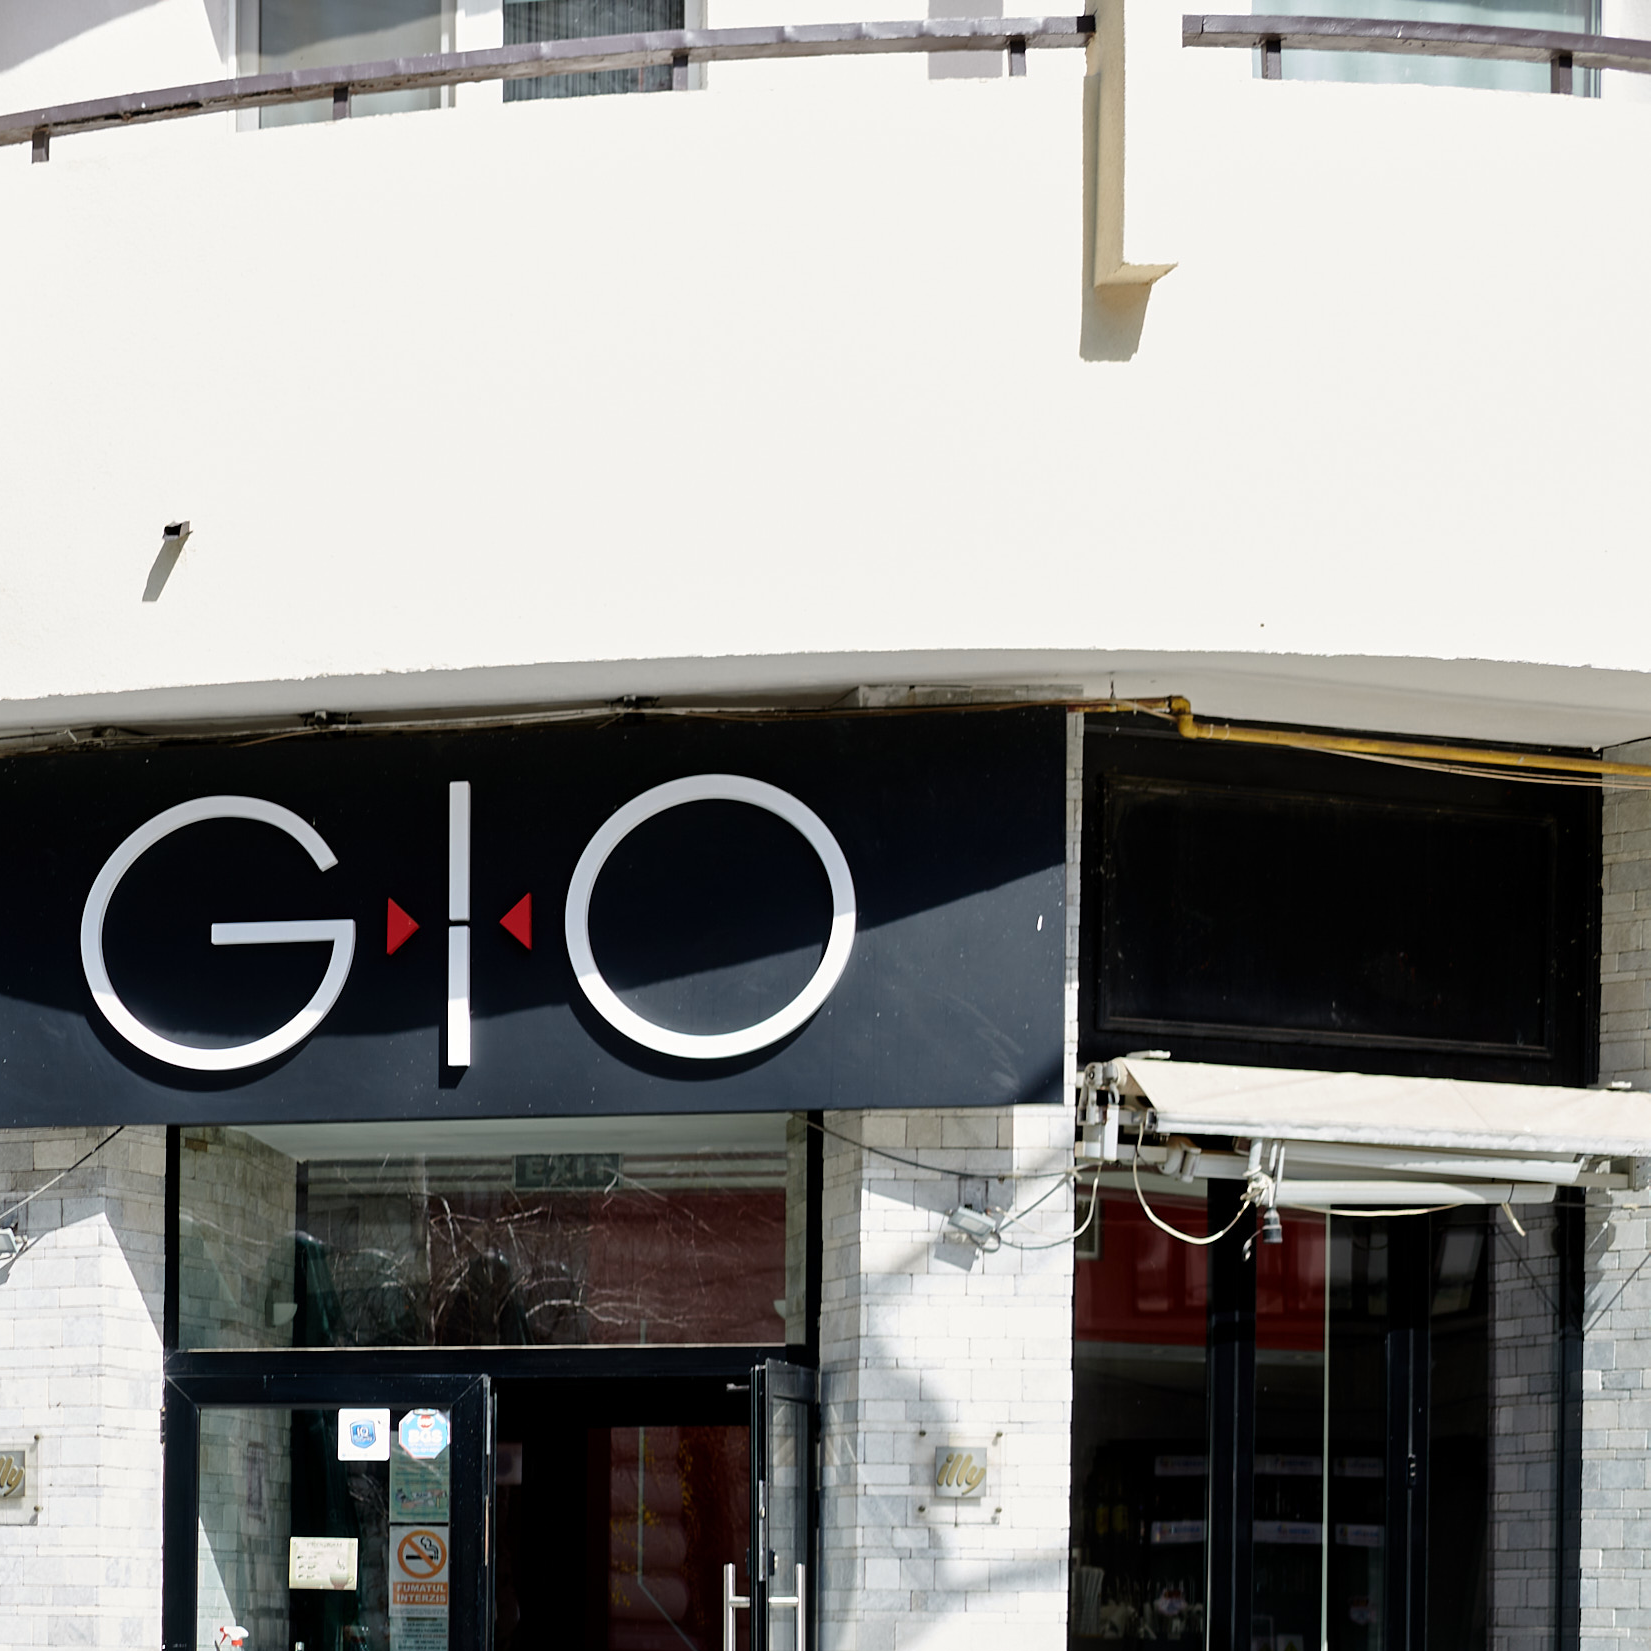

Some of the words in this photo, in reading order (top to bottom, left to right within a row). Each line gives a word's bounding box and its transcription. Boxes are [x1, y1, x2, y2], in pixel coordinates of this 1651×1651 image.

[80, 773, 857, 1072] GIO
[937, 1452, 986, 1496] illy
[396, 1584, 446, 1593] FUMATUL
[396, 1594, 446, 1603] INTERZIS
